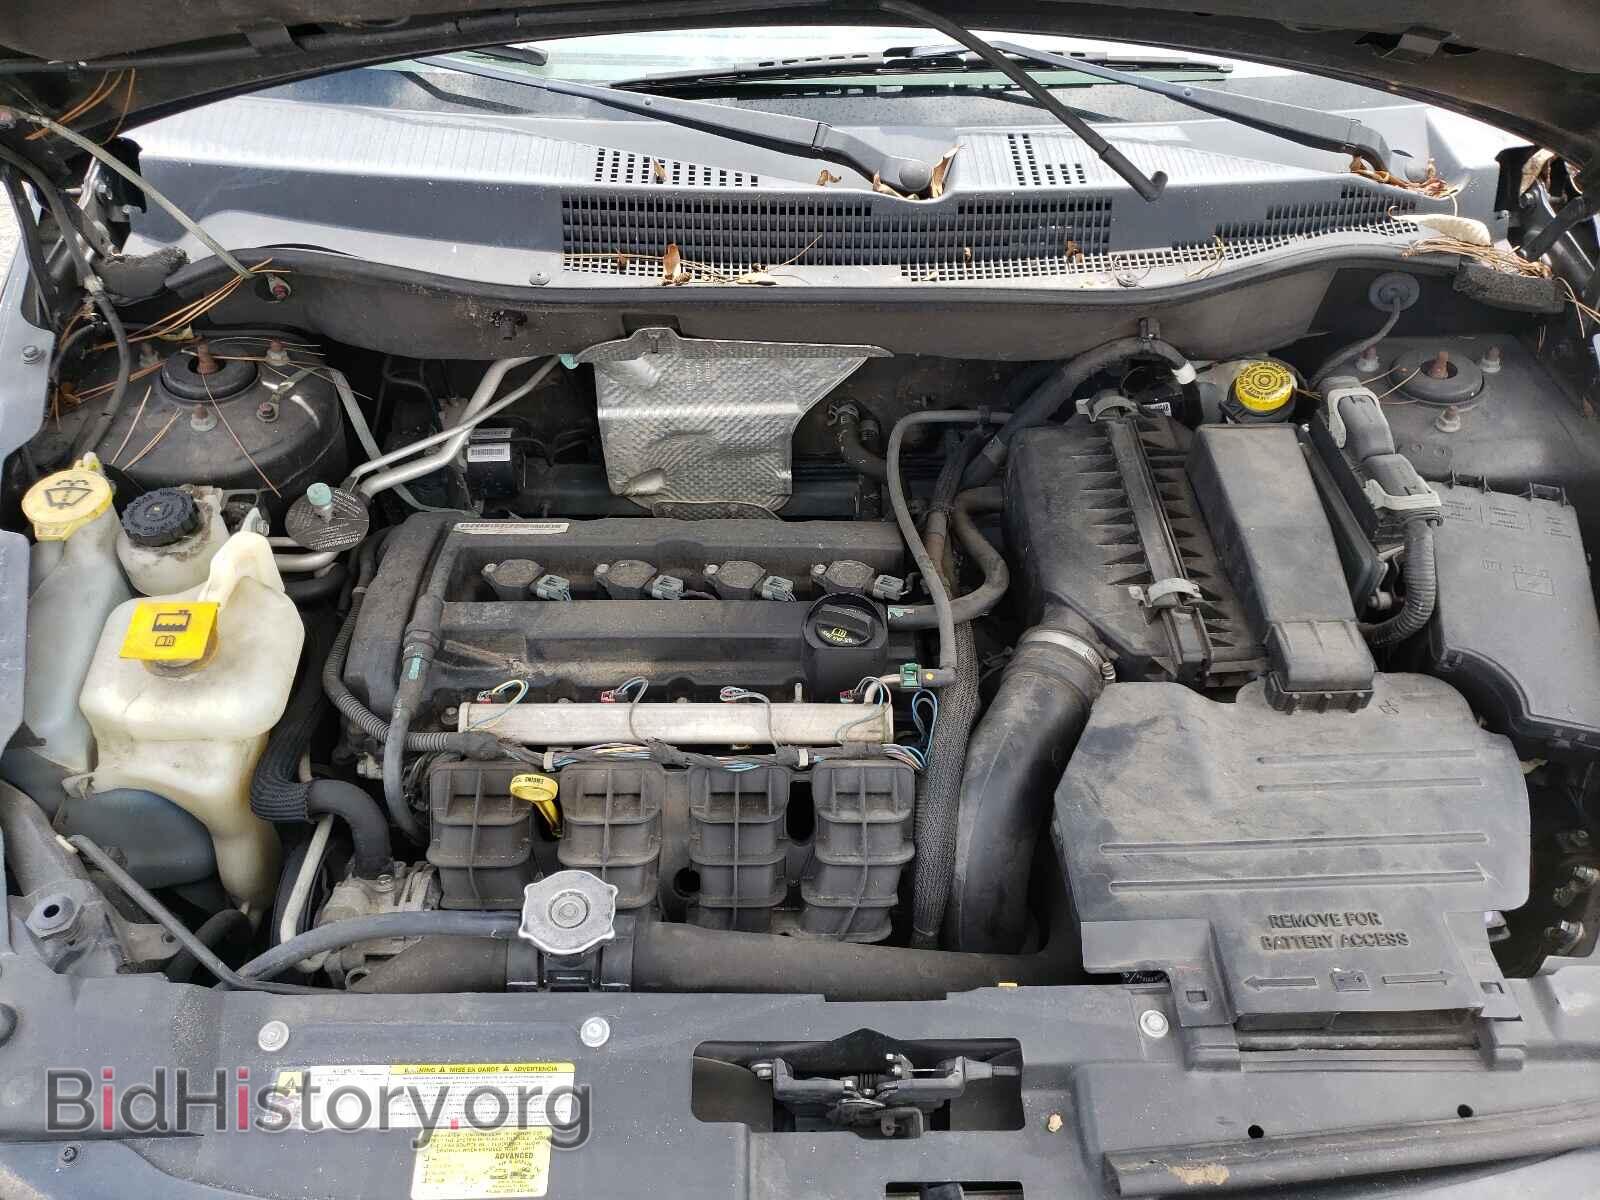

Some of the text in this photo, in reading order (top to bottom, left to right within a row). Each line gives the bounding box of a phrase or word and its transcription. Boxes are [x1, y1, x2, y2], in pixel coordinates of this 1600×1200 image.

[1268, 911, 1383, 929] REMOVE FOR
[1260, 932, 1410, 951] BATTERY ACCESS
